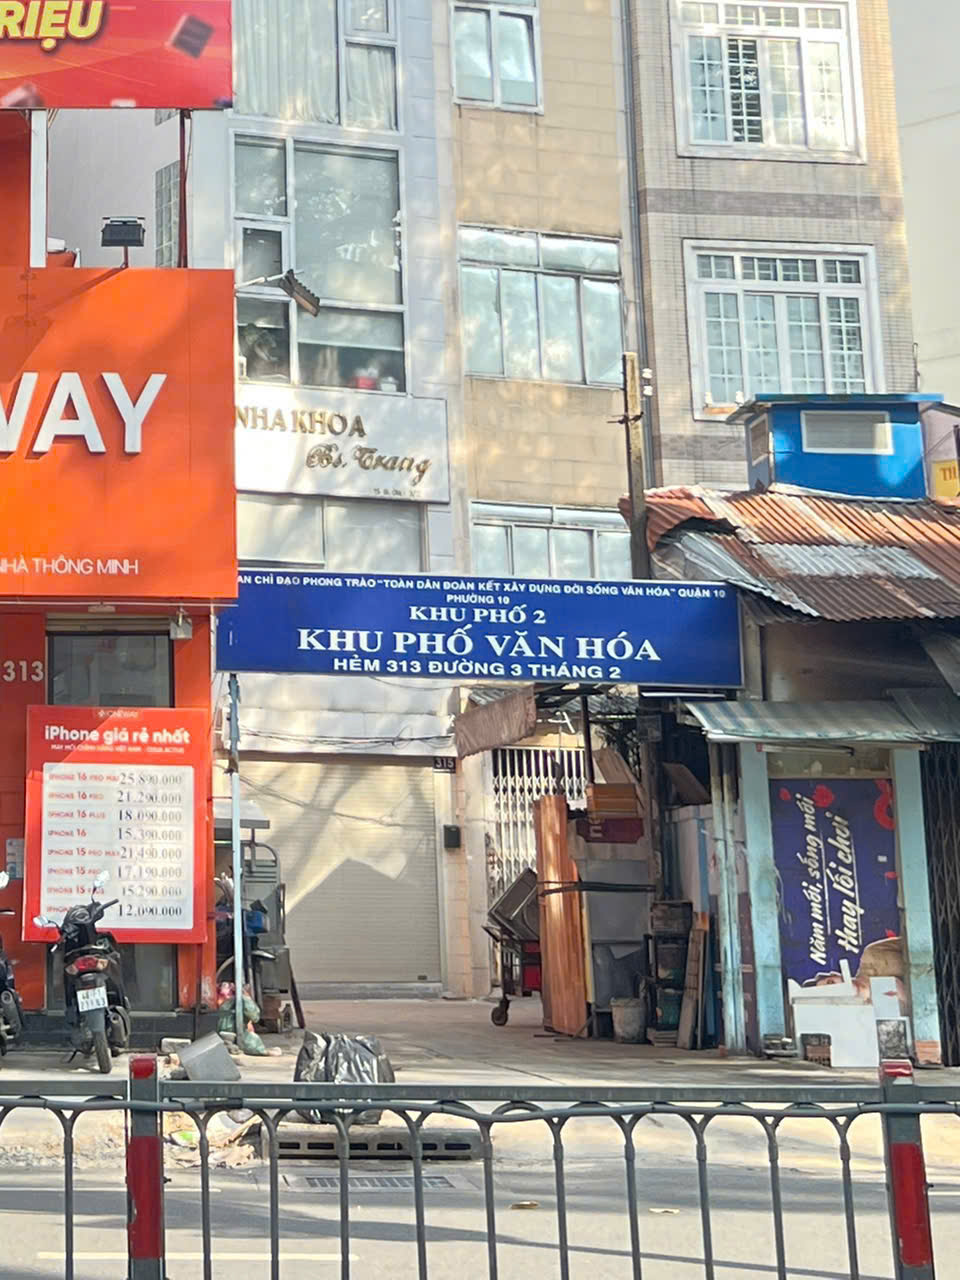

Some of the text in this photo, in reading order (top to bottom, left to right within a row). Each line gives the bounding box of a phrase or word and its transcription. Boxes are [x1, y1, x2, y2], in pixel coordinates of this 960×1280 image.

[235, 406, 366, 438] NHA KHOA
[353, 445, 432, 486] Trang
[32, 554, 93, 575] THÔNG
[97, 558, 138, 575] MINH
[237, 575, 252, 584] AN
[303, 577, 342, 587] PHONG
[344, 575, 376, 588] TRÀO
[416, 579, 440, 590] DÂN
[443, 580, 475, 591] ĐOÀN
[478, 580, 501, 592] KẾT
[503, 581, 527, 592] XÂY
[529, 583, 561, 595] DỰNG
[586, 582, 618, 595] SỐNG
[621, 584, 643, 596] VĂN
[678, 587, 710, 599] QUẬN
[713, 589, 726, 599] 10
[446, 593, 510, 605] PHƯỜNG 10
[409, 605, 547, 624] KHU PHỐ 2
[297, 624, 661, 661] KHU PHỐ VĂN HÓA
[3, 660, 43, 682] 313
[334, 655, 621, 679] HẺM 313 ĐƯỜNG 3 THÁNG 2
[45, 725, 190, 745] iPhone giá rẻ nhất
[435, 758, 454, 769] 315
[78, 772, 87, 781] 16
[78, 791, 87, 799] 16
[77, 809, 86, 818] 16
[795, 792, 816, 832] mới
[796, 835, 823, 880] sống
[826, 811, 864, 954] thay lối chơi
[809, 922, 827, 965] Năm
